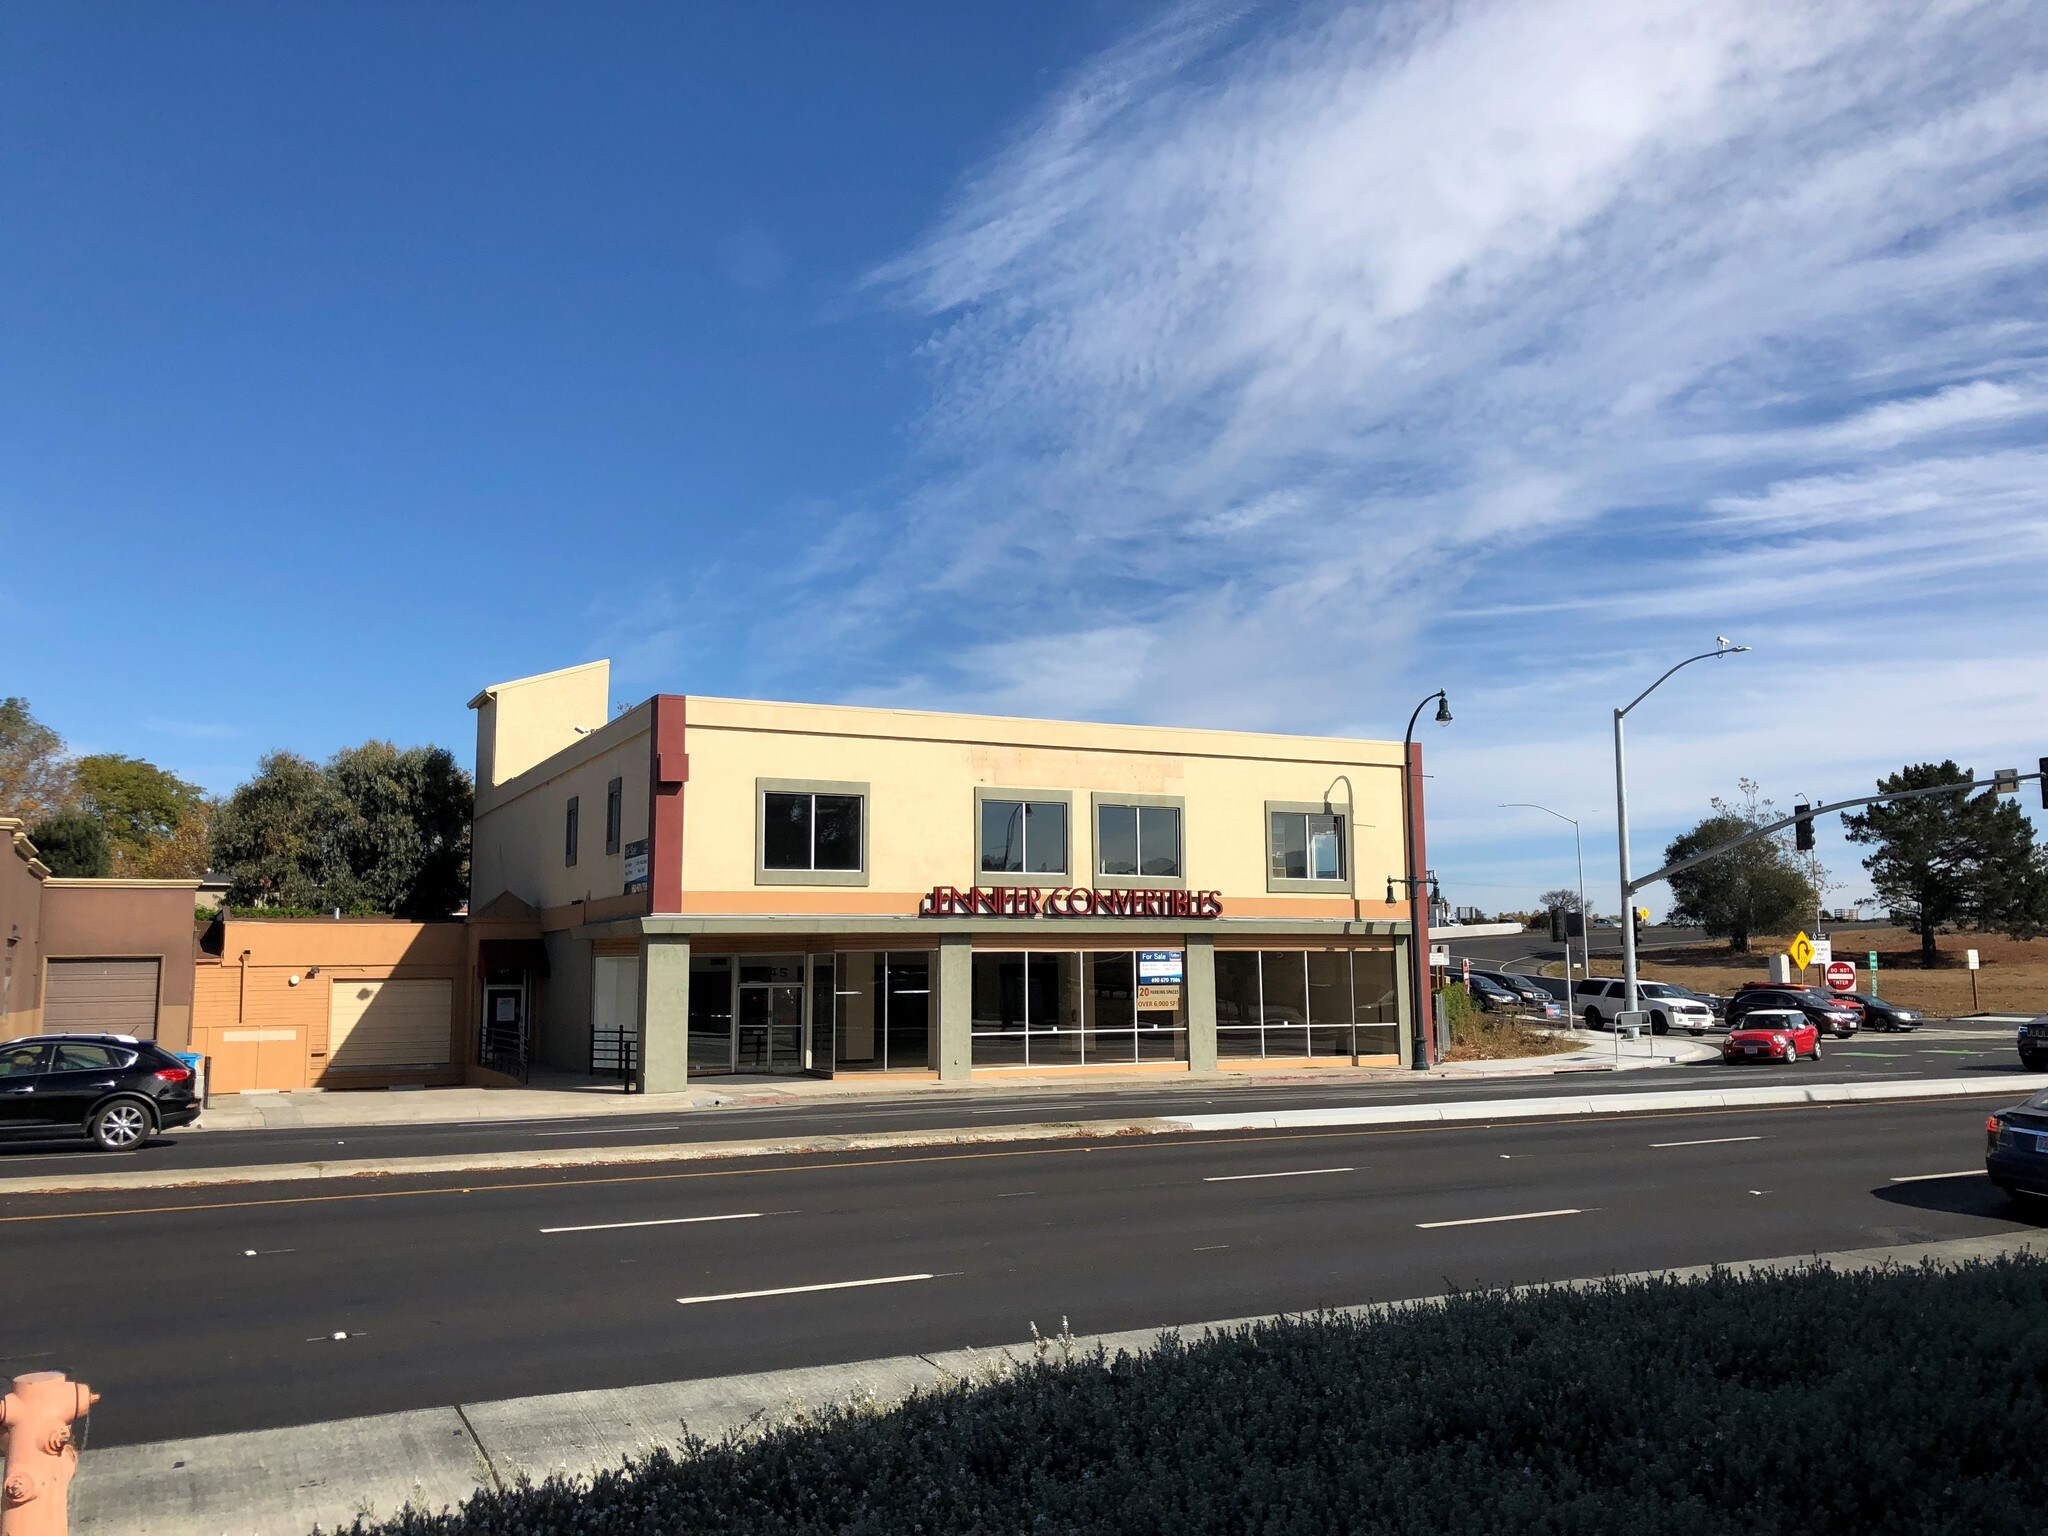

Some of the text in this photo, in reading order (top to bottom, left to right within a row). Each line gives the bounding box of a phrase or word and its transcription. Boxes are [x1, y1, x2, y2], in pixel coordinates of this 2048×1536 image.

[924, 886, 1223, 917] JENNIFER CONVERTIBLES
[1139, 988, 1149, 996] 20
